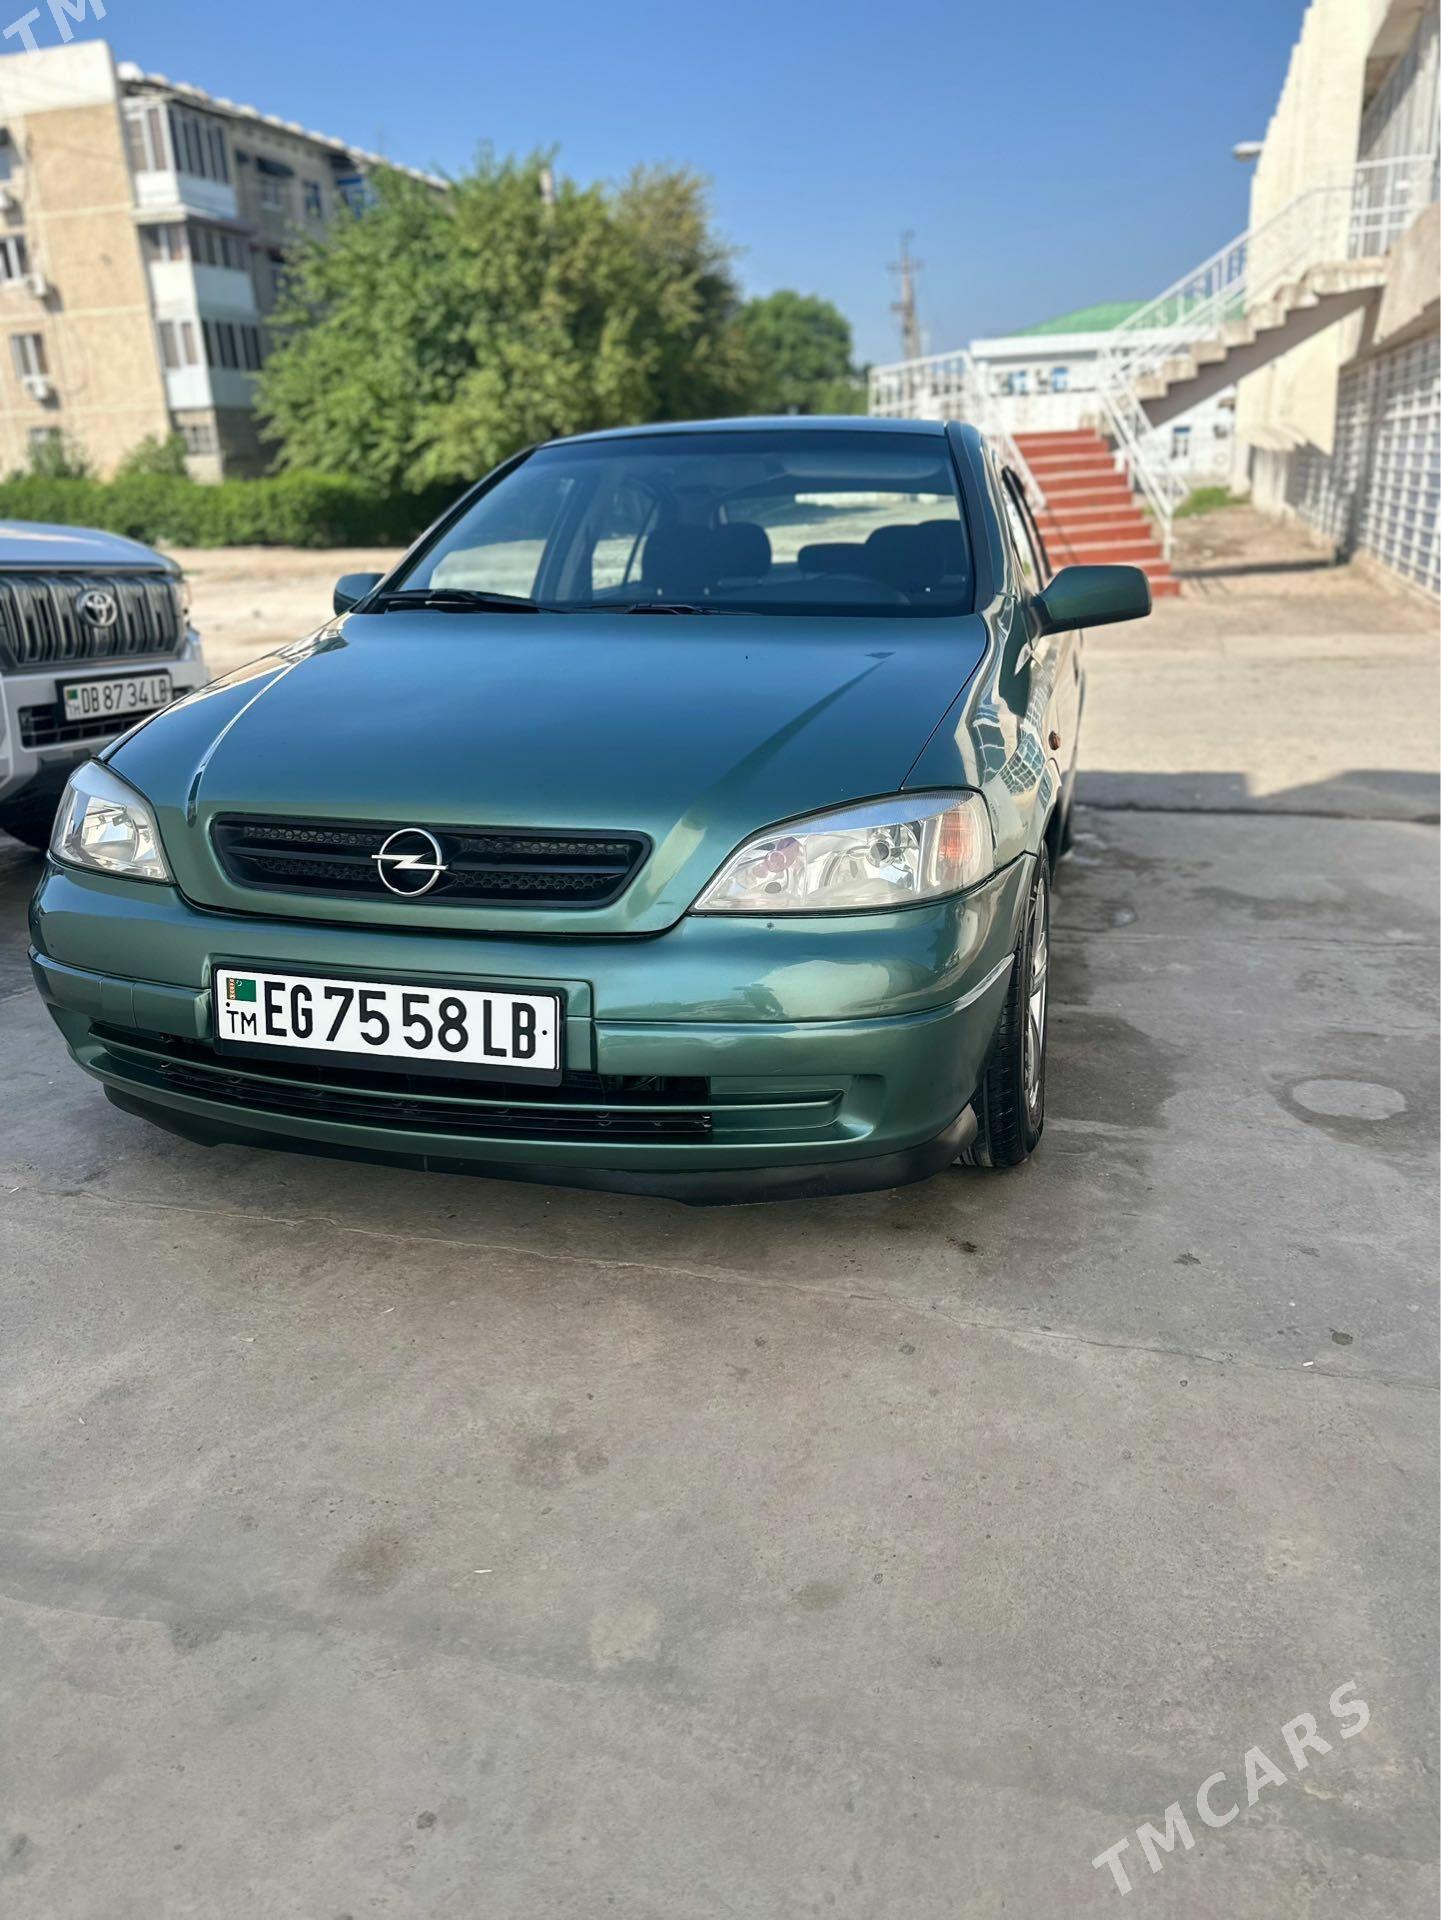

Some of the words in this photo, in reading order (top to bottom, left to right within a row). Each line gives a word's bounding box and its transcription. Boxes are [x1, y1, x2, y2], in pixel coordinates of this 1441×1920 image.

[226, 1009, 258, 1036] TM
[263, 980, 313, 1039] EG
[483, 999, 537, 1059] LB
